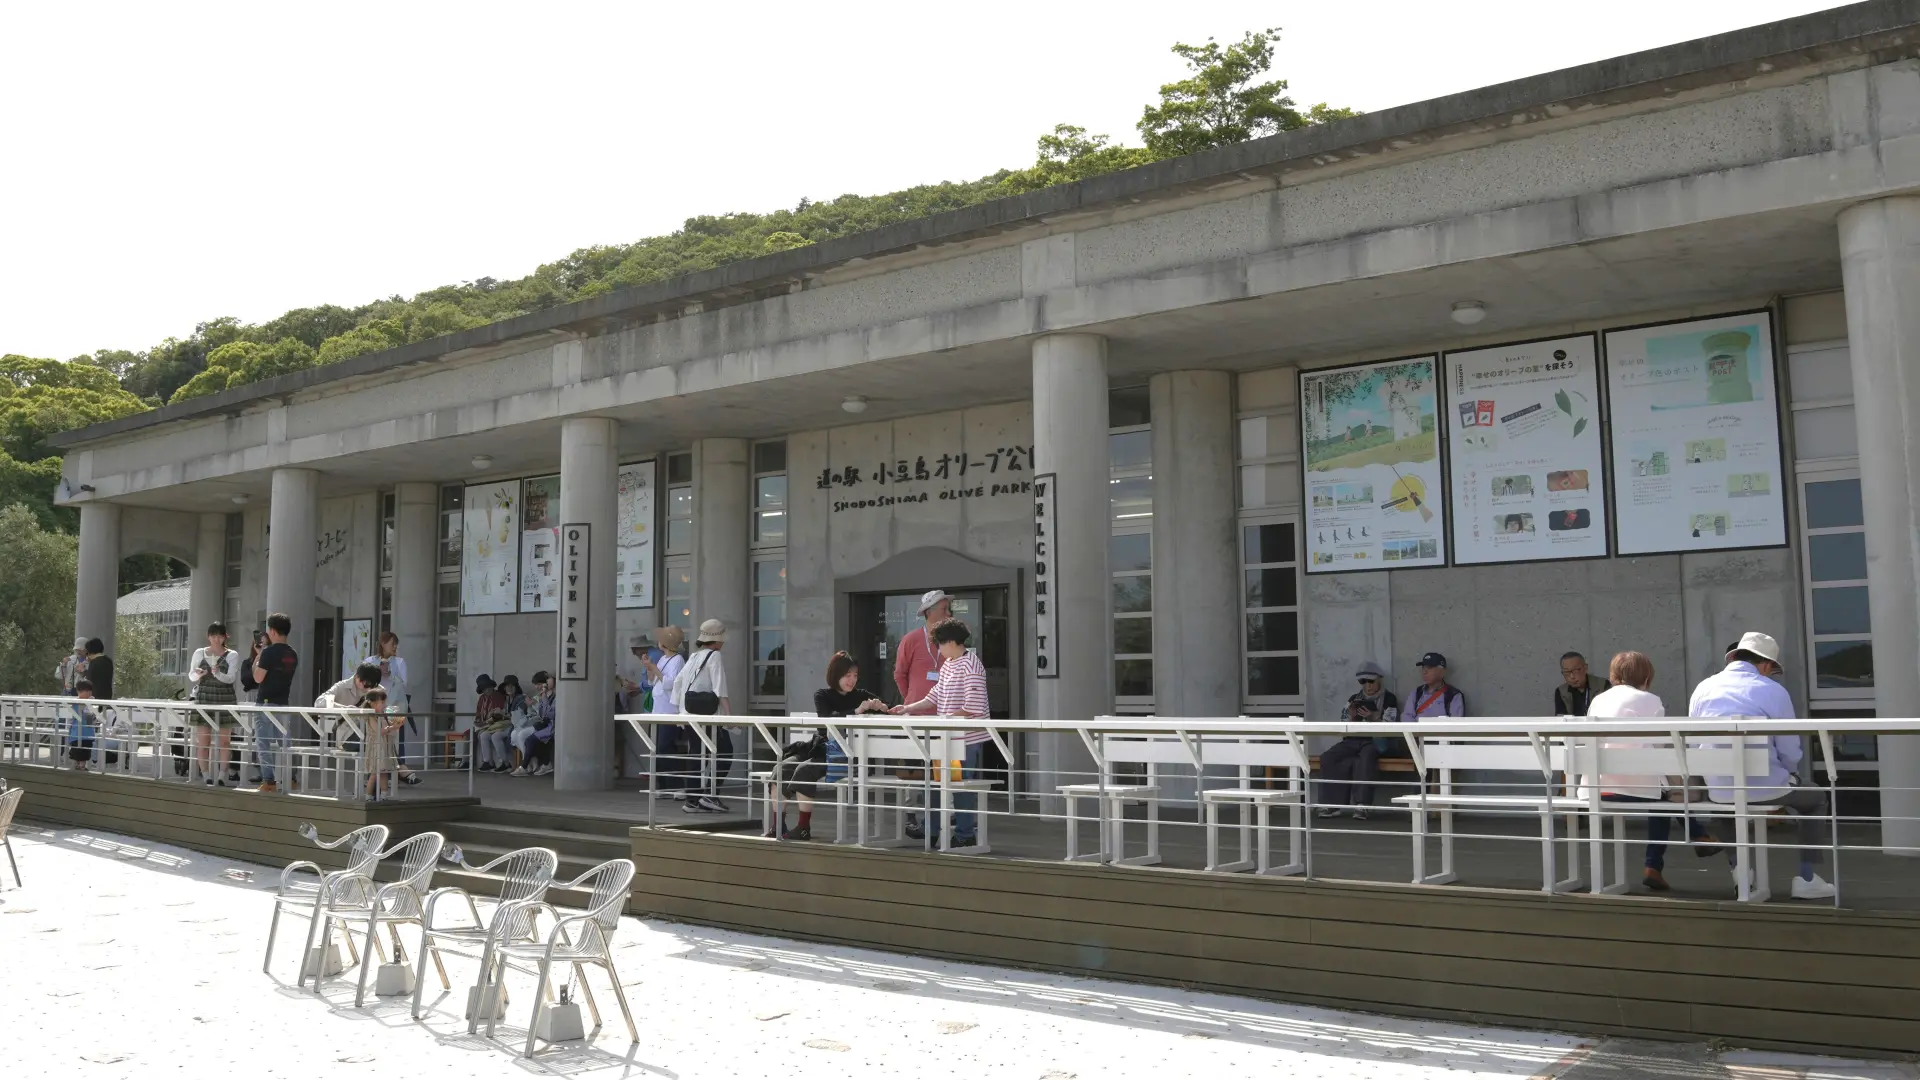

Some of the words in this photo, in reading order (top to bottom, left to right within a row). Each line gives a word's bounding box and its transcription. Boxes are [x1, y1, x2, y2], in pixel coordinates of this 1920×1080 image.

[817, 466, 862, 489] 道の駅
[834, 491, 928, 513] SHODOSHIMA
[939, 486, 984, 500] OLIVE
[991, 481, 1031, 497] PARK
[568, 530, 579, 602] OLIVE
[1034, 483, 1047, 615] WELCOME
[566, 616, 577, 674] PARK
[1037, 636, 1048, 670] TO
